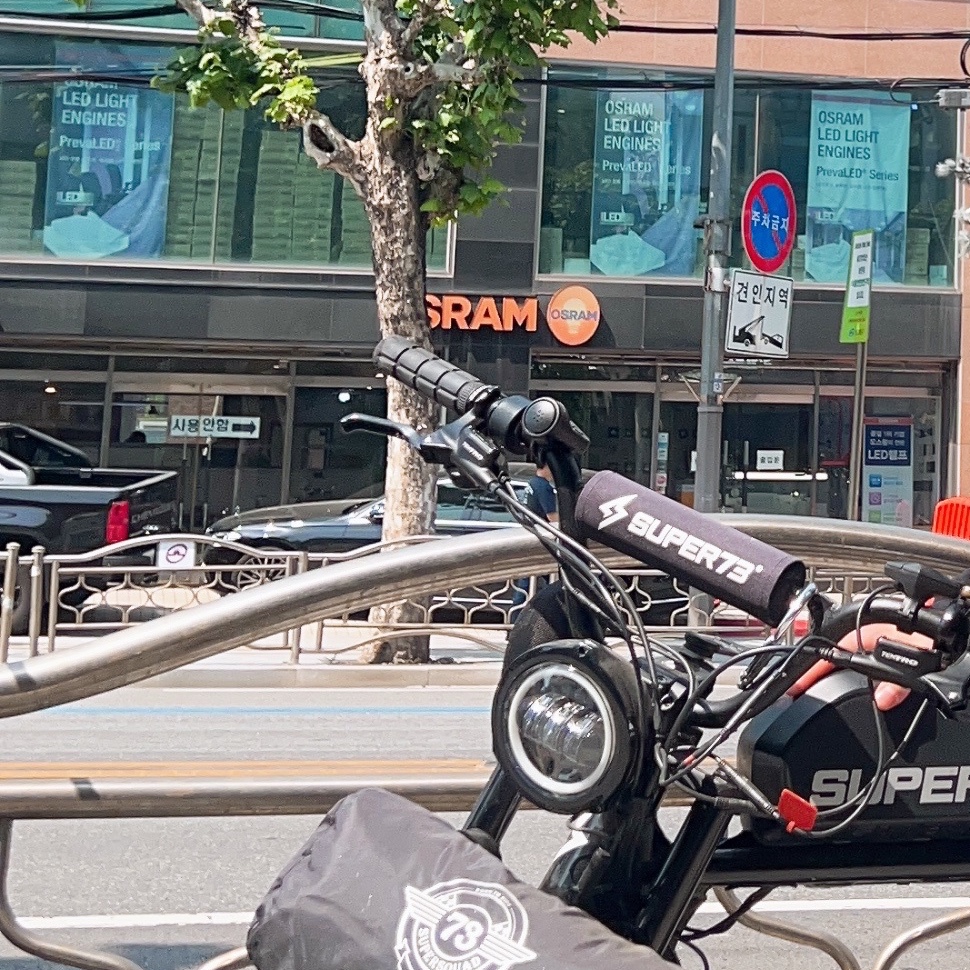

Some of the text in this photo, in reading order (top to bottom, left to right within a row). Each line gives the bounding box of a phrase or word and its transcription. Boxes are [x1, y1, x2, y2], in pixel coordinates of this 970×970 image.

[62, 91, 91, 106] LED
[605, 100, 654, 116] OSRAM
[61, 109, 127, 128] ENGINES
[604, 118, 630, 132] LED
[818, 111, 864, 126] OSRAM
[603, 135, 661, 151] ENGINES
[817, 127, 880, 144] LED LIGHT
[817, 145, 871, 160] ENGINES
[869, 169, 899, 181] Series
[751, 211, 789, 234] 주차금지
[736, 281, 789, 309] 견인지역
[550, 308, 599, 322] OSRAM
